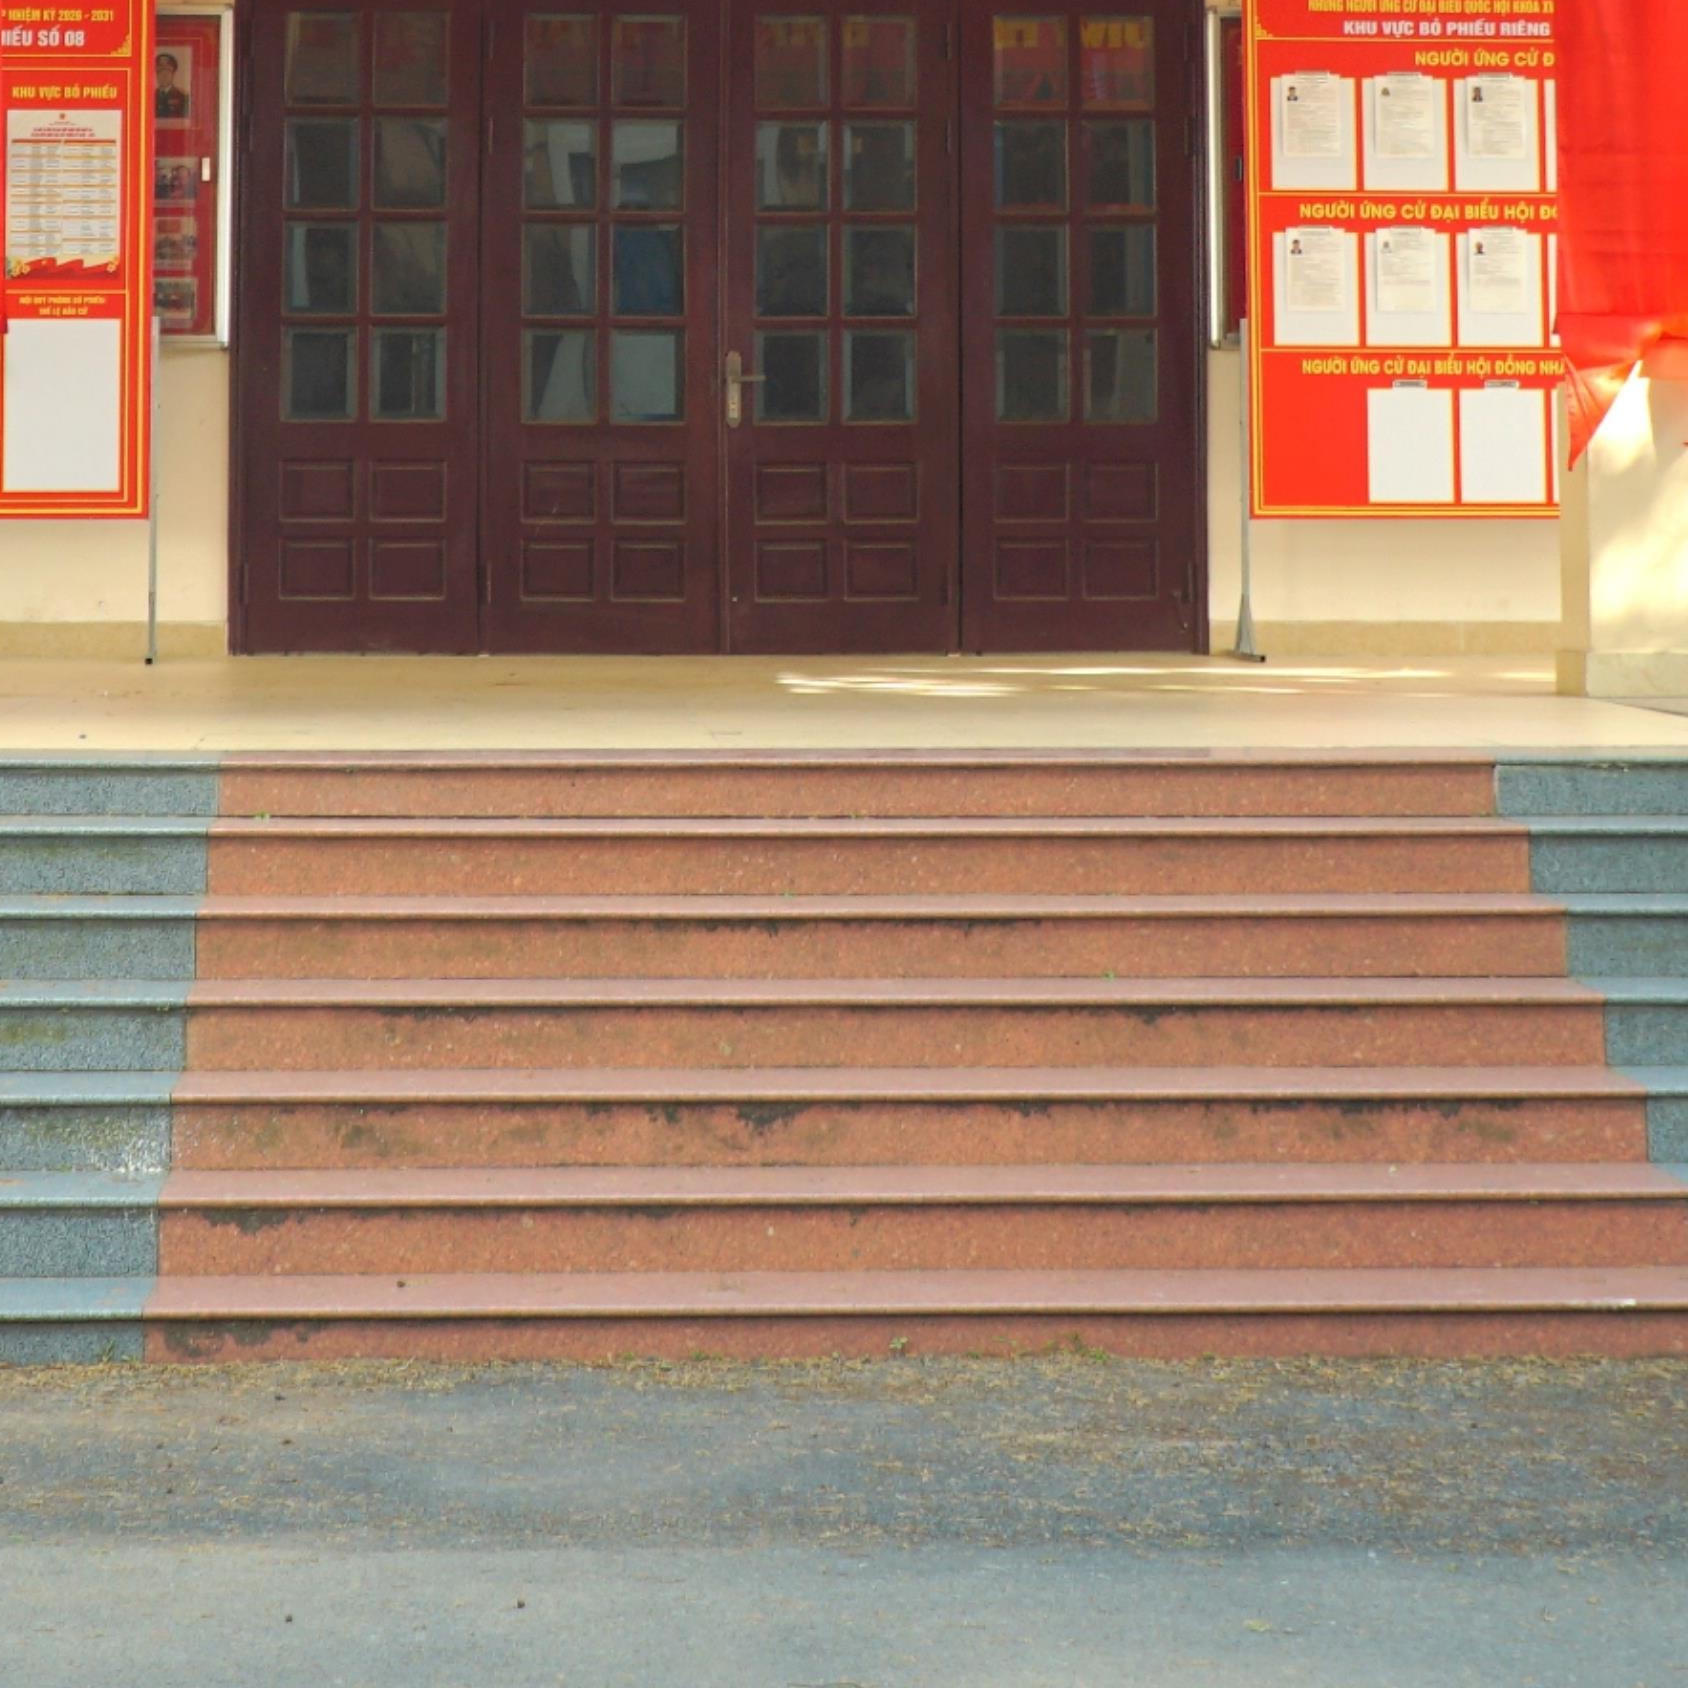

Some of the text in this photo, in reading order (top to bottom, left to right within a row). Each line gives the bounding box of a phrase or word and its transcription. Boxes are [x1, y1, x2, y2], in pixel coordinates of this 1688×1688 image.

[91, 10, 114, 21] 2031
[1, 25, 32, 46] IẾU
[37, 26, 60, 47] SỐ
[64, 30, 85, 47] 08
[1343, 21, 1377, 36] KHU
[1381, 20, 1415, 39] VỰC
[1419, 18, 1442, 36] BỎ
[1446, 17, 1496, 36] PHIẾU
[1500, 19, 1551, 37] RIÊNG
[1415, 49, 1468, 66] NGƯỜI
[1473, 47, 1510, 67] ỨNG
[1514, 47, 1538, 67] CỬ
[12, 87, 35, 99] KHU
[39, 86, 61, 101] VỰC
[83, 84, 117, 99] PHIẾU
[1299, 200, 1355, 219] NGƯỜI
[1360, 201, 1397, 219] ỨNG
[1401, 201, 1426, 219] CỬ
[1430, 204, 1459, 223] ĐẠI
[1465, 198, 1499, 219] BIỂU
[1504, 201, 1534, 223] HỘI
[1302, 356, 1346, 374] NGƯỜI
[1351, 356, 1380, 374] ỨNG
[1384, 355, 1405, 374] CỬ
[1408, 360, 1431, 378] ĐẠI
[1434, 352, 1462, 374] BIỂU
[1467, 357, 1491, 377] HỘI
[1495, 354, 1536, 374] ĐỒNG
